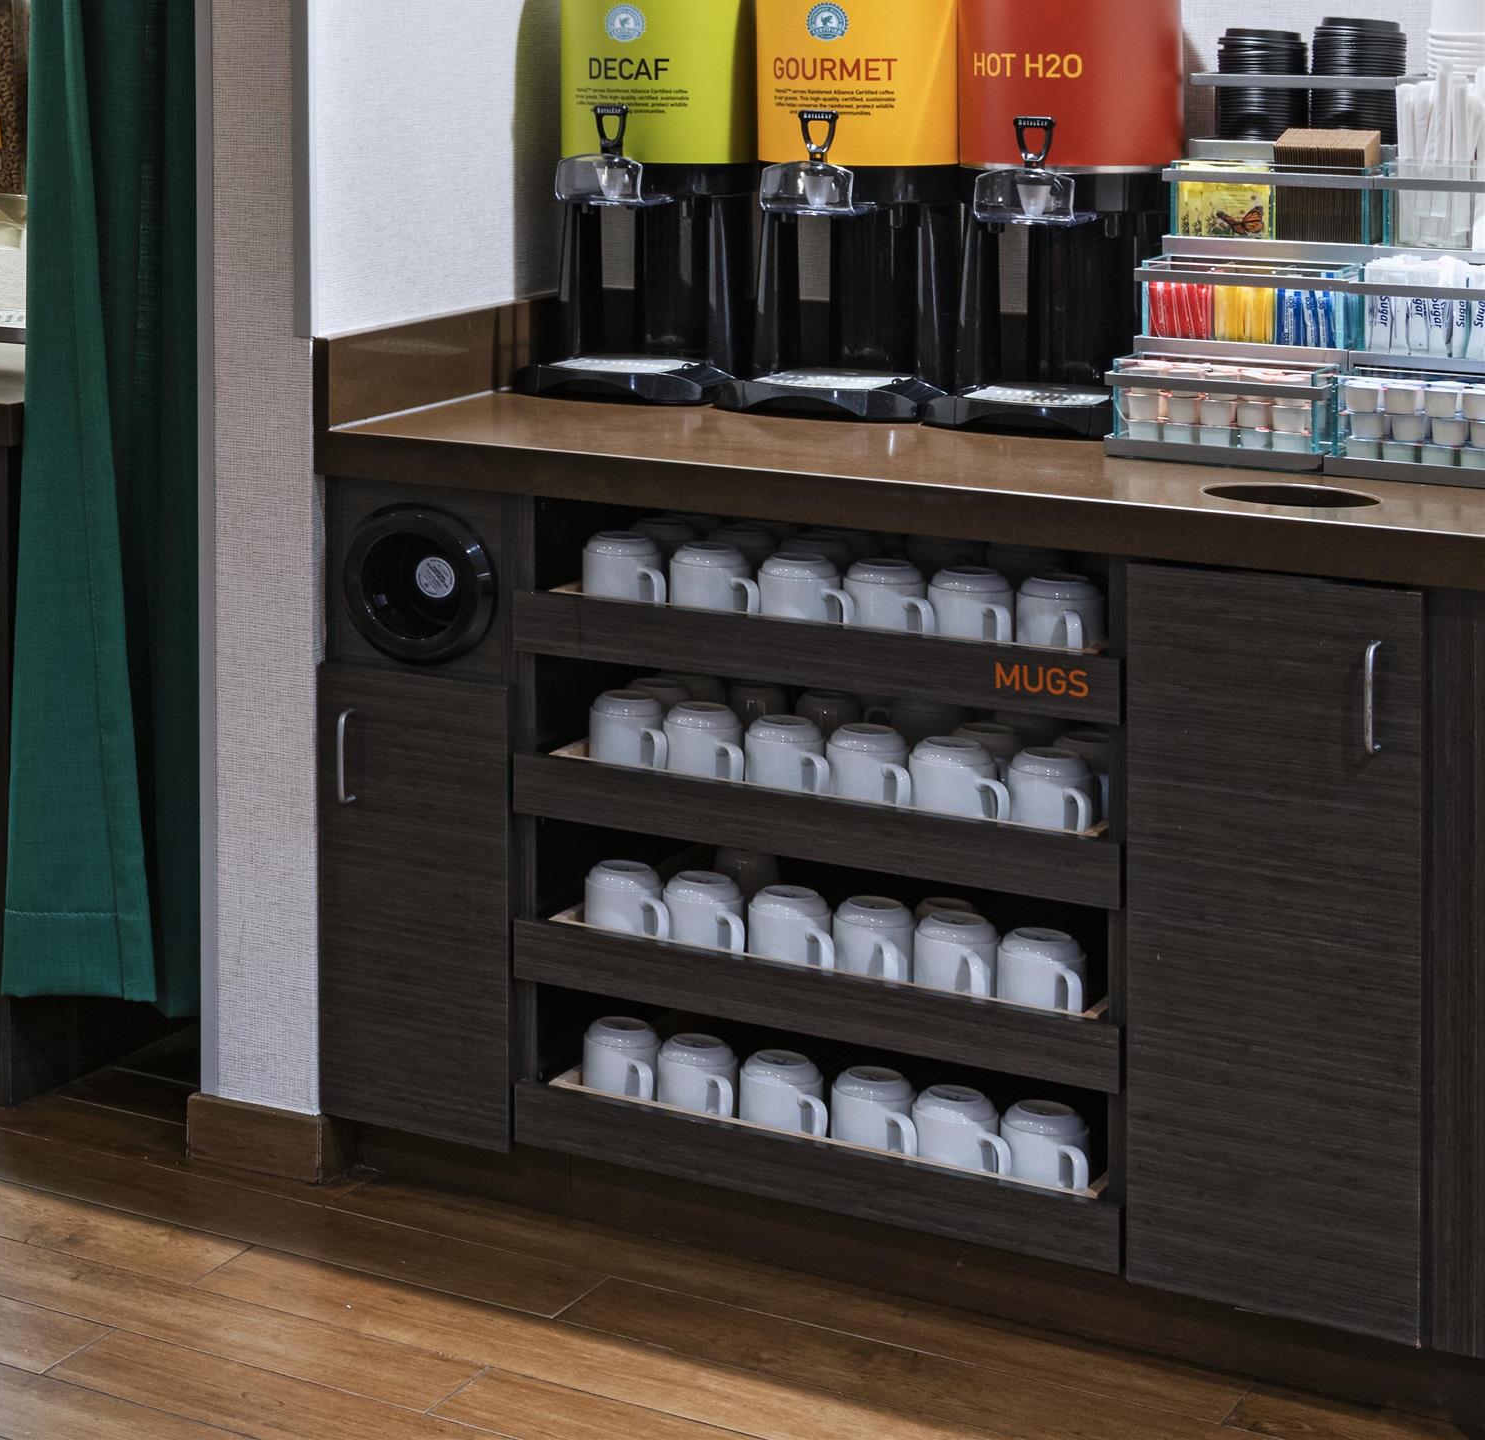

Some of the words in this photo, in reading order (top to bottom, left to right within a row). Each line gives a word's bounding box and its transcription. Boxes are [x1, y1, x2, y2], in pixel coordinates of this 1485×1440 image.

[588, 57, 670, 80] DECAF
[773, 56, 898, 81] GOURMET
[973, 52, 1017, 77] HOT
[1024, 53, 1083, 78] H2O
[1379, 295, 1389, 328] Sugar
[1412, 297, 1423, 317] gar
[1455, 300, 1467, 328] Suga
[1473, 300, 1485, 328] Suga
[994, 661, 1090, 698] MUGS
